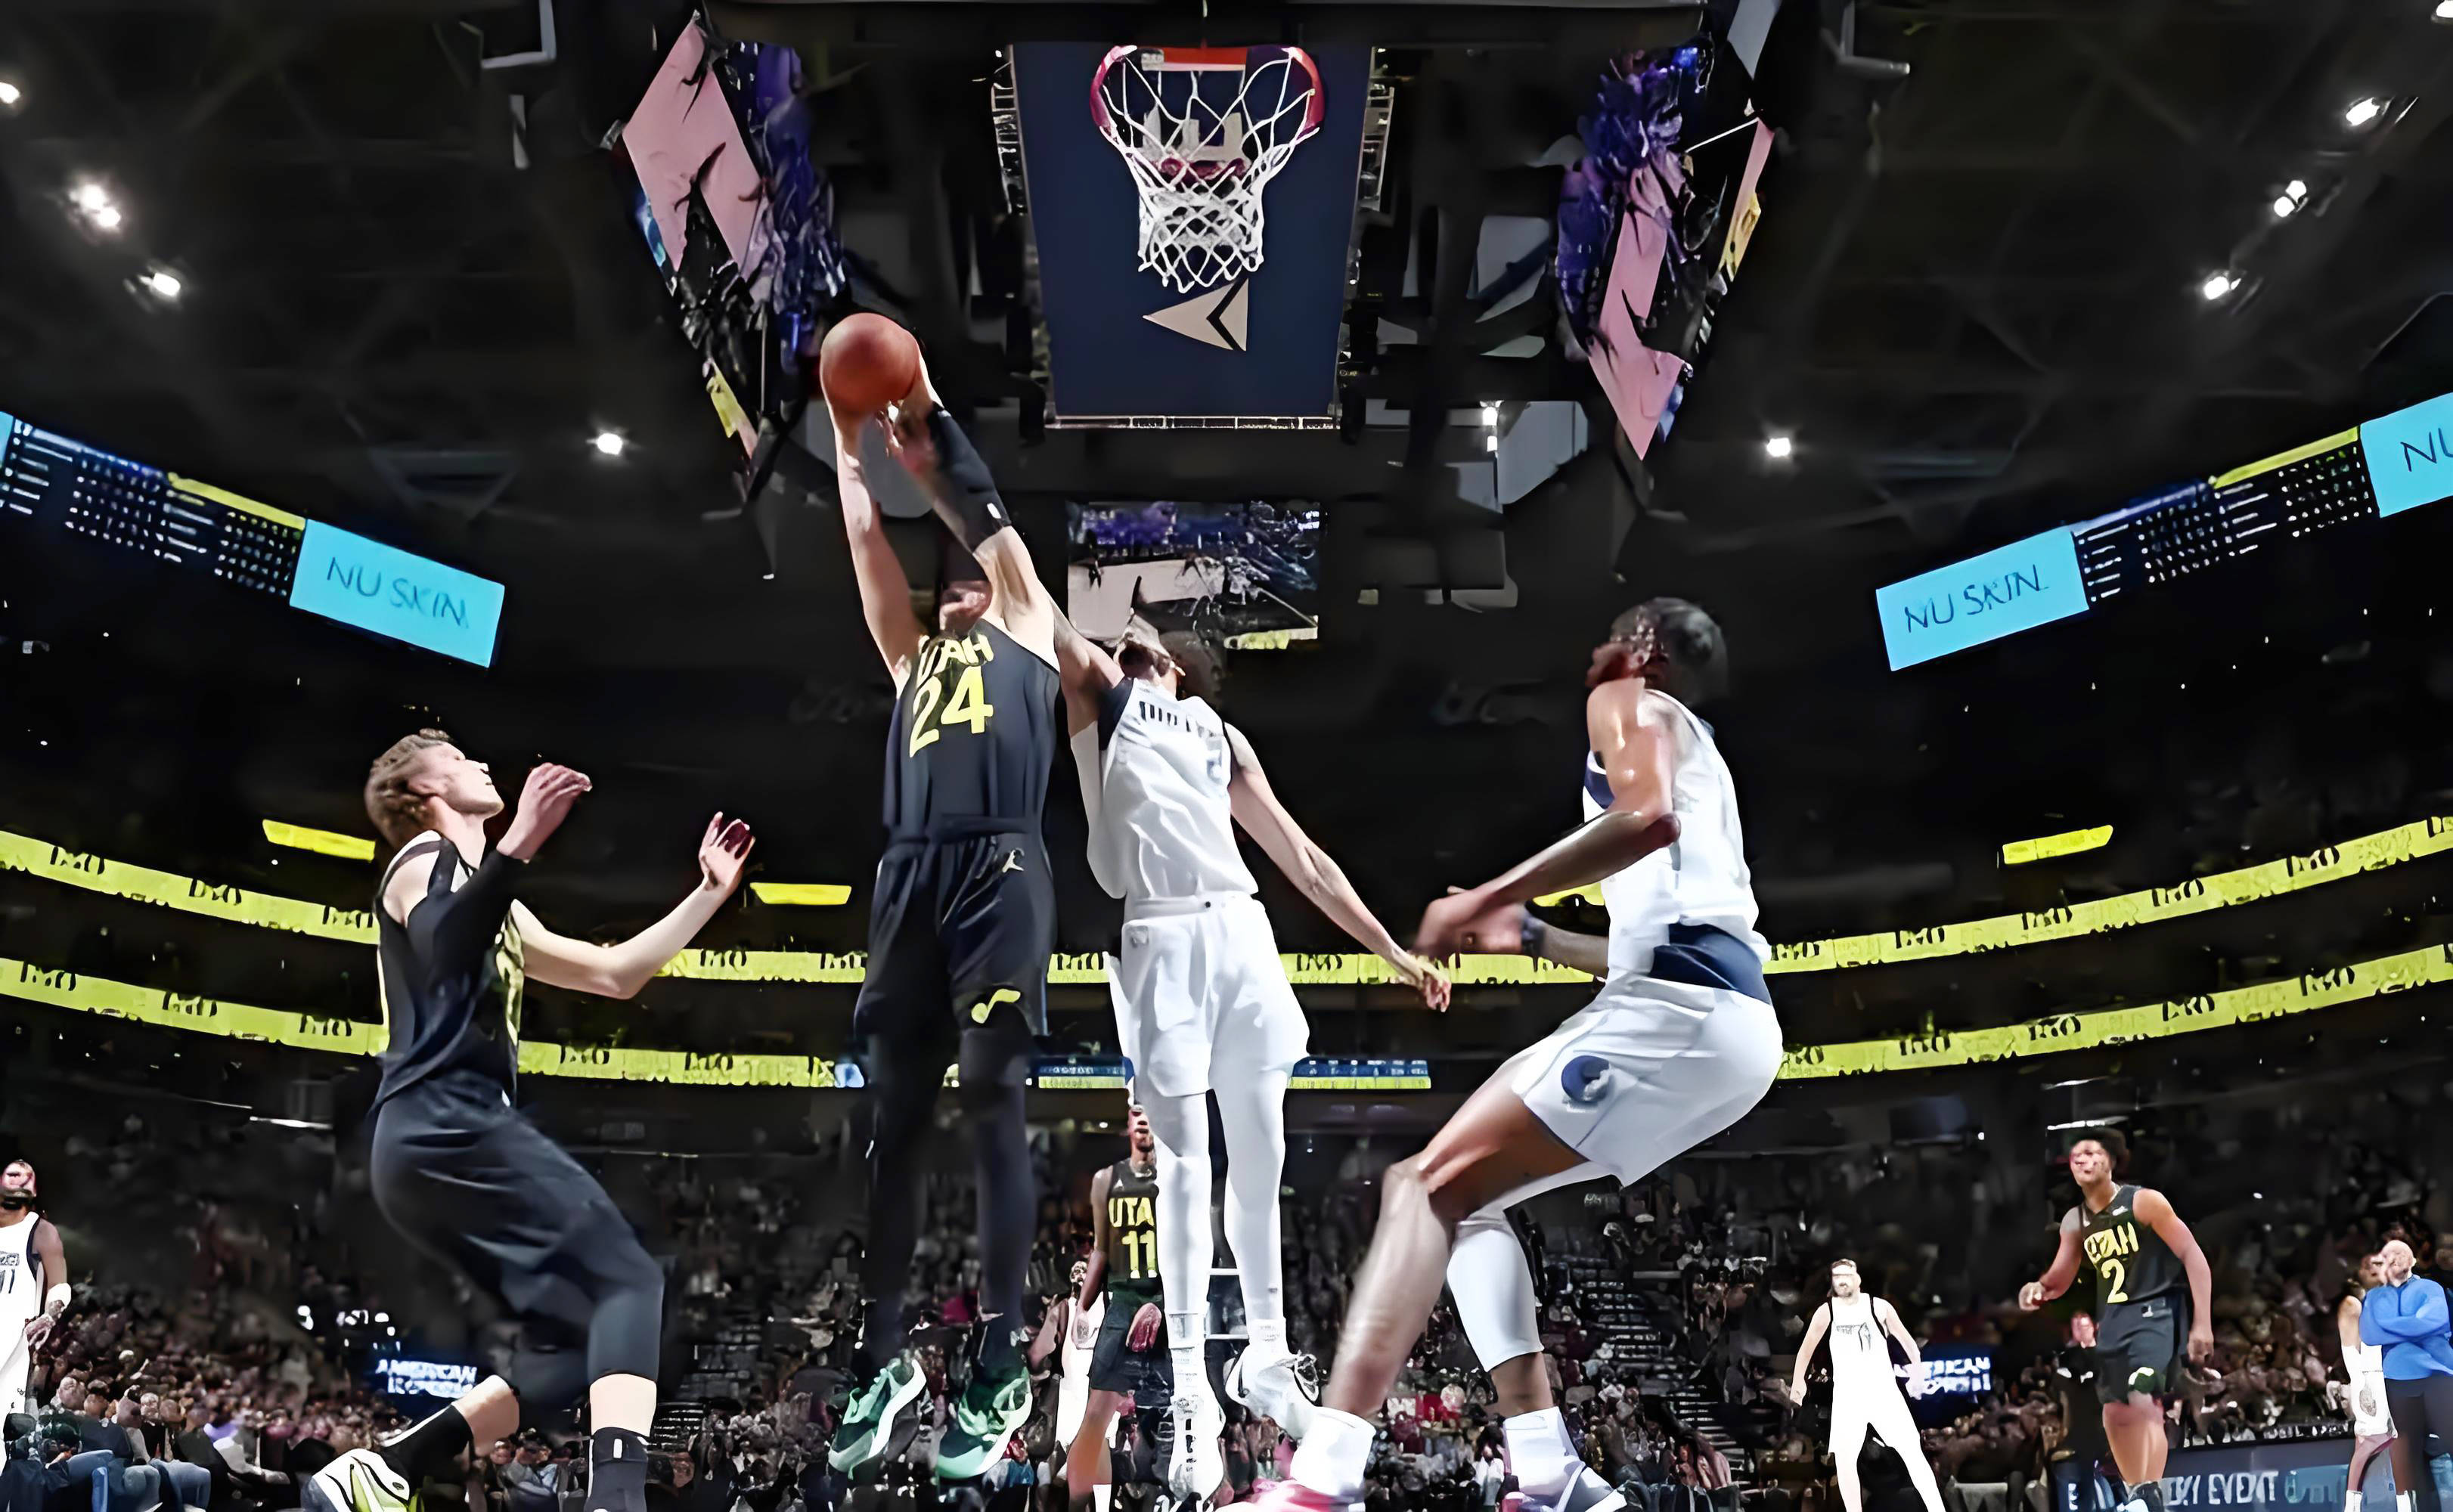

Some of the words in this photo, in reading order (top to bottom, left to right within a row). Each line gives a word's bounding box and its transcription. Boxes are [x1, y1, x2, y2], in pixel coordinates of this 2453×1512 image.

[327, 556, 382, 597] NU
[389, 578, 469, 629] SKIN
[1904, 593, 1955, 633] NU
[1964, 564, 2045, 615] SKIN
[909, 665, 994, 758] 24
[1121, 1230, 1158, 1279] 11
[2101, 1258, 2129, 1304] 2
